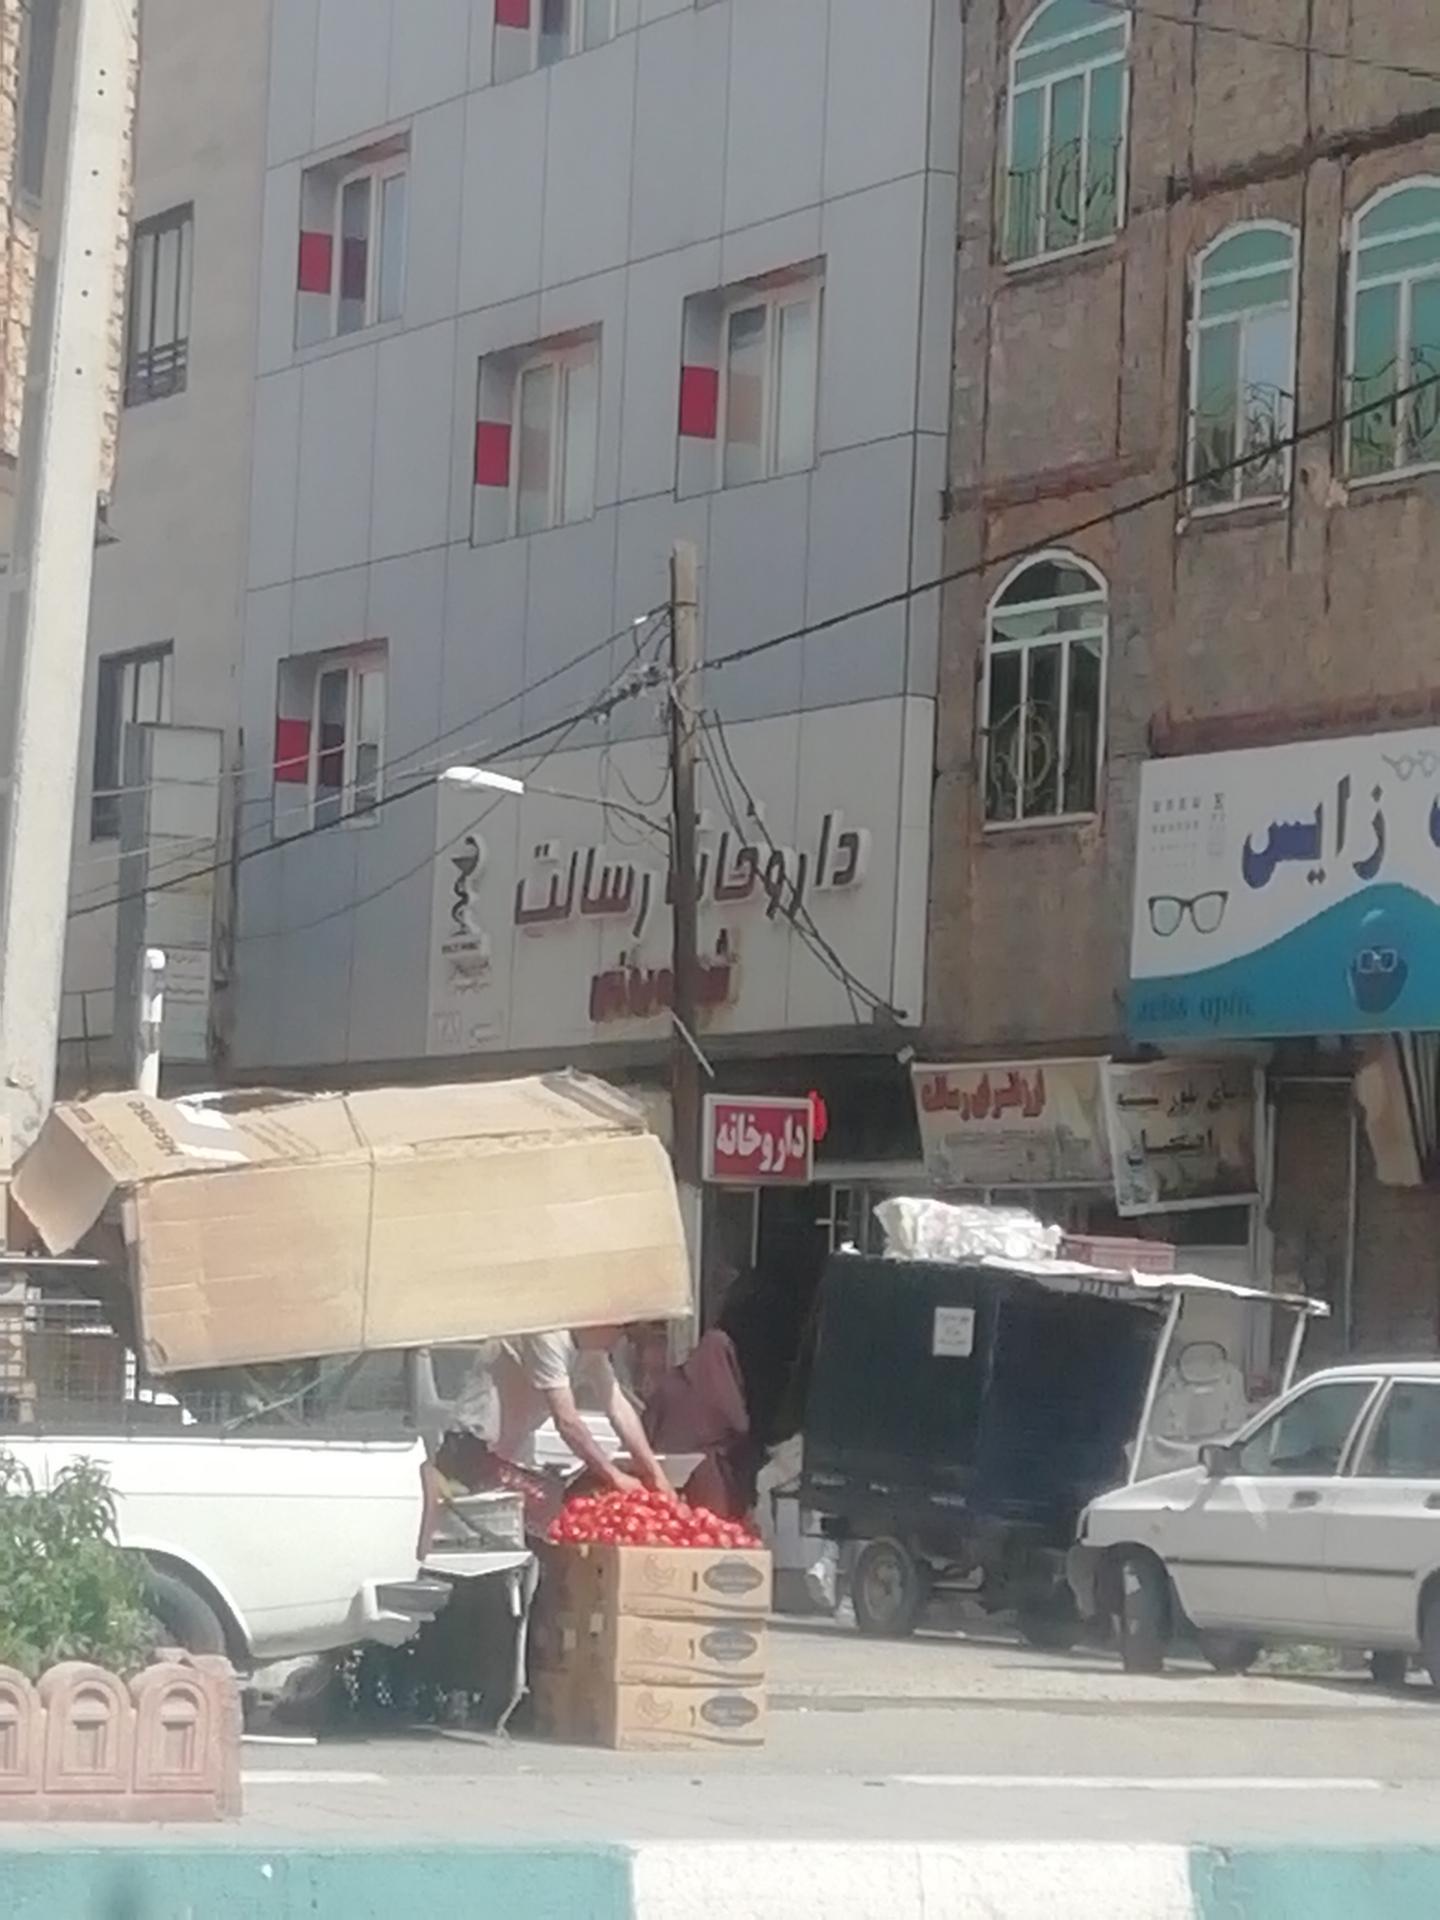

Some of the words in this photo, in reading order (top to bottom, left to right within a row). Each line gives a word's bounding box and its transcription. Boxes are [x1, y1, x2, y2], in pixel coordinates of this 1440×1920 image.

[664, 801, 860, 920] داروخان
[1242, 774, 1386, 889] زایس
[515, 842, 650, 938] رسالت
[716, 1112, 806, 1172] داروخانه
